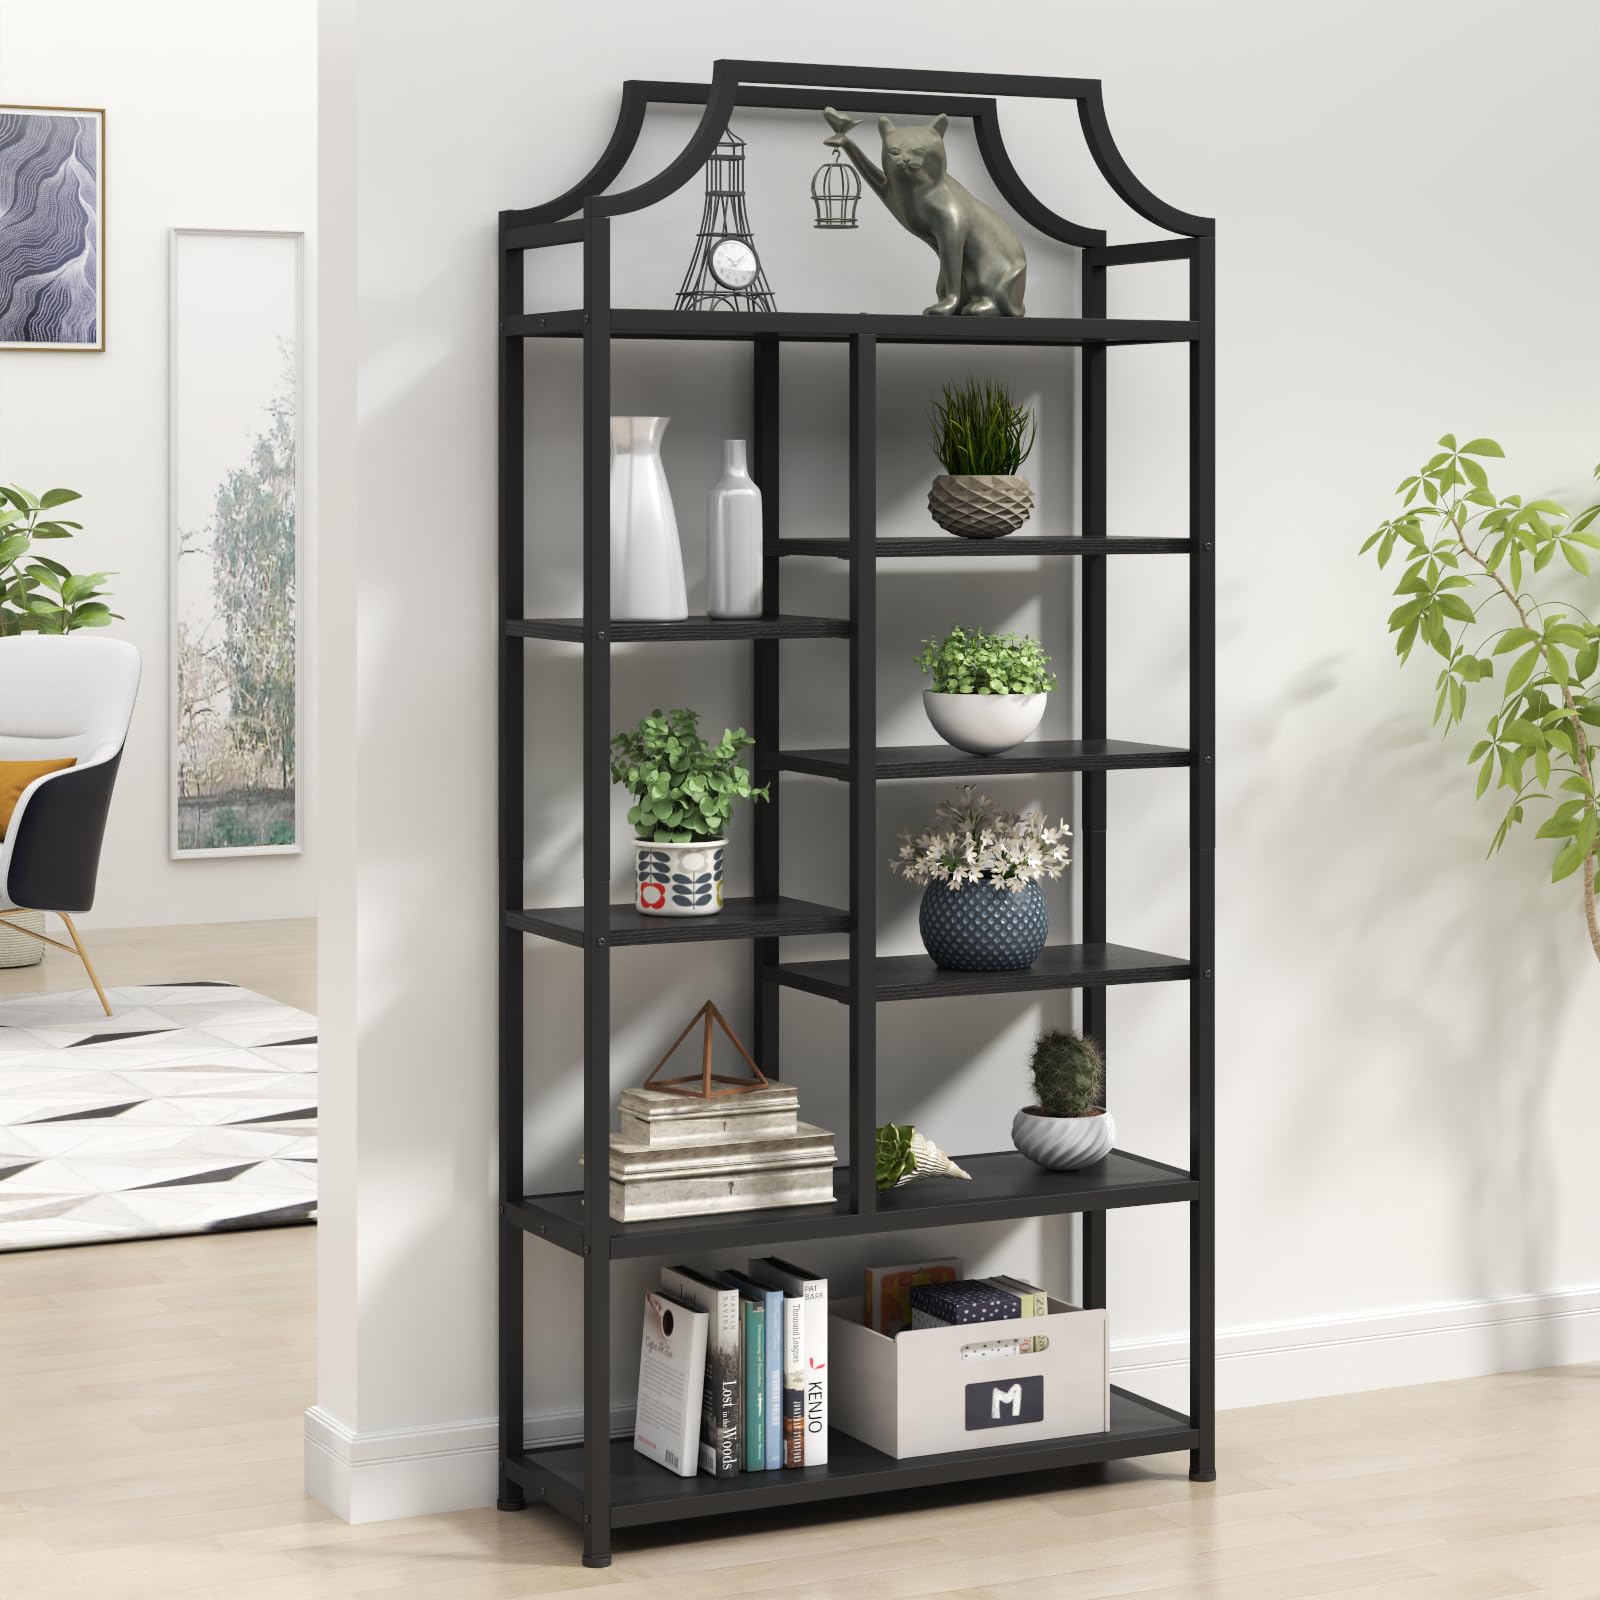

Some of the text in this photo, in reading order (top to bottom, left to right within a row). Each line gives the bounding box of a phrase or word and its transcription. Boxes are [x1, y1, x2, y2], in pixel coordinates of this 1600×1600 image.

[804, 1292, 824, 1301] BARR
[790, 1303, 801, 1363] Thousand Leagues
[722, 1380, 737, 1408] Lost
[808, 1381, 823, 1434] KENJO
[991, 1383, 1022, 1419] M
[722, 1418, 731, 1428] the
[722, 1426, 737, 1470] Woods
